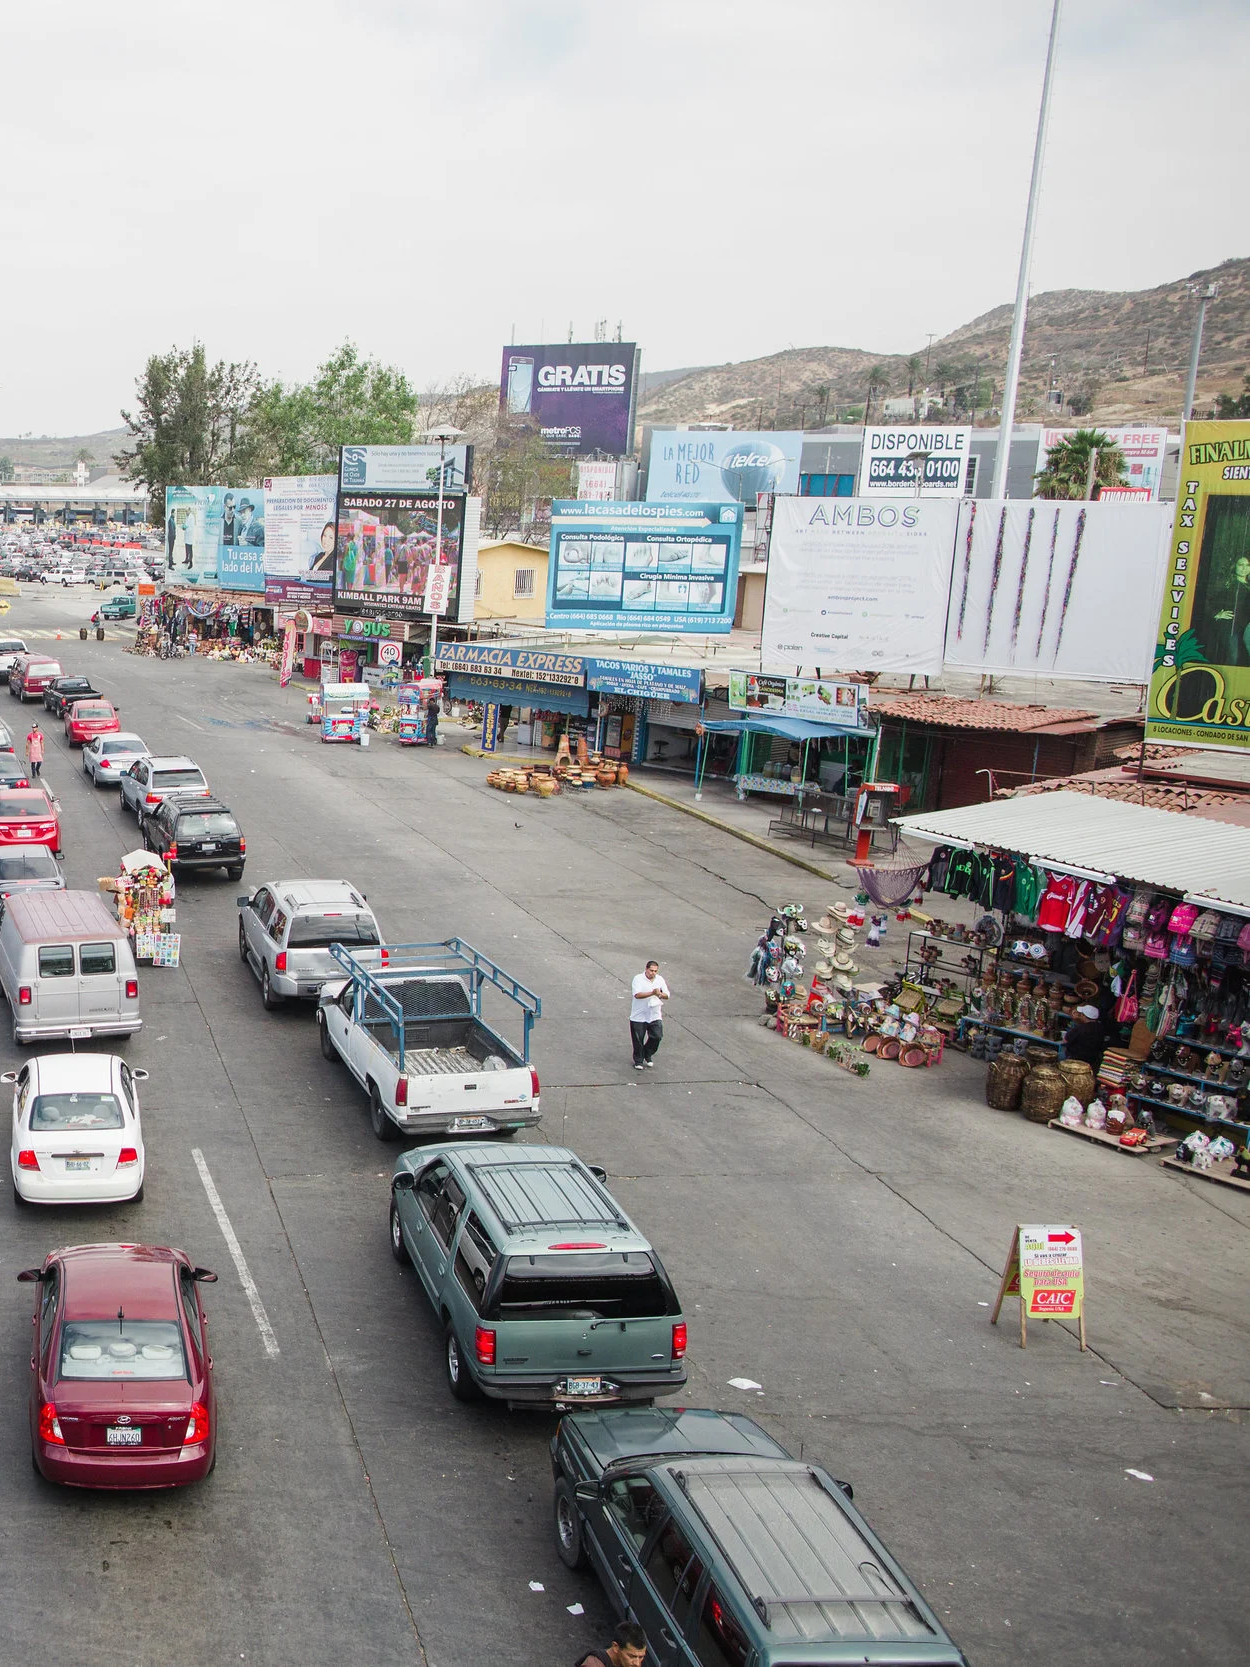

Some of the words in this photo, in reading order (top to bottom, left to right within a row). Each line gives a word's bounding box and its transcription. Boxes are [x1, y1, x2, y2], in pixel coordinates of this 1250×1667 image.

[538, 364, 626, 386] GRATIS
[541, 426, 582, 435] metroPCS
[871, 434, 965, 450] DISPONIBLE
[1123, 434, 1161, 444] FREE
[664, 446, 674, 461] LA
[678, 442, 715, 461] MEJOR
[580, 466, 615, 474] DISPONIBLE
[676, 463, 700, 485] RED
[871, 460, 895, 477] 664
[926, 461, 959, 477] 0100
[344, 498, 383, 507] SABADO
[385, 499, 396, 508] 27
[399, 500, 413, 508] DE
[414, 500, 455, 510] AGOSTO
[560, 504, 704, 519] www.lacasadelospies.com
[1180, 481, 1200, 528] TAX
[809, 504, 921, 528] AMBOS
[590, 534, 625, 542] Podológica
[676, 536, 713, 544] Ortopédica
[227, 549, 238, 560] Tu
[240, 552, 258, 561] casa
[222, 561, 239, 573] lado
[240, 562, 253, 573] del
[338, 591, 375, 602] KIMBALL
[377, 594, 401, 604] PARK
[402, 595, 422, 606] 9AM
[1162, 540, 1190, 668] SERVICES
[688, 616, 704, 624] (619)
[384, 648, 396, 656] 40
[439, 645, 512, 666] FARMACIA
[516, 652, 583, 674] EXPRESS
[452, 662, 469, 672] (664)
[470, 665, 482, 673] 683
[484, 666, 492, 675] 63
[494, 667, 502, 675] 34
[511, 669, 535, 679] Nextel:
[596, 660, 620, 670] TACOS
[621, 663, 649, 673] VARIOS
[650, 666, 656, 674] Y
[657, 666, 692, 678] TAMALES
[1158, 726, 1193, 736] LOCACIONES
[1196, 730, 1226, 739] CONDADO
[1236, 734, 1249, 742] SAN
[1024, 1269, 1050, 1279] Seguro
[1052, 1270, 1061, 1278] de
[1061, 1270, 1080, 1278] auto
[1037, 1292, 1072, 1305] CAIC
